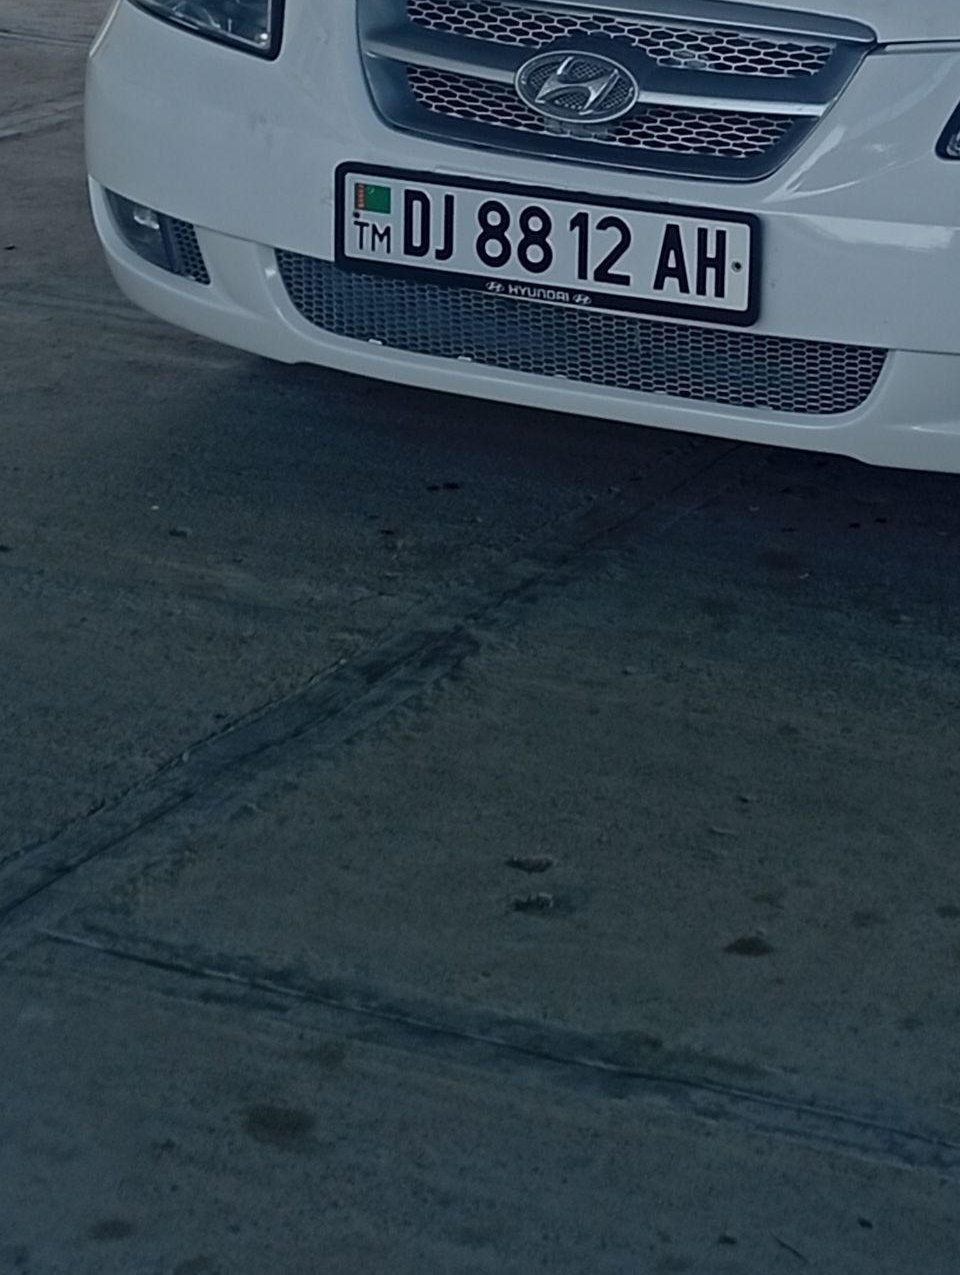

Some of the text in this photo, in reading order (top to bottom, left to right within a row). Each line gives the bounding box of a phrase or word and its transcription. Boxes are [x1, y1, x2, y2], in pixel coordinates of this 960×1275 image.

[354, 221, 391, 254] TM
[403, 188, 727, 298] DJ 8812 AH
[508, 284, 570, 302] HYUNDAI
